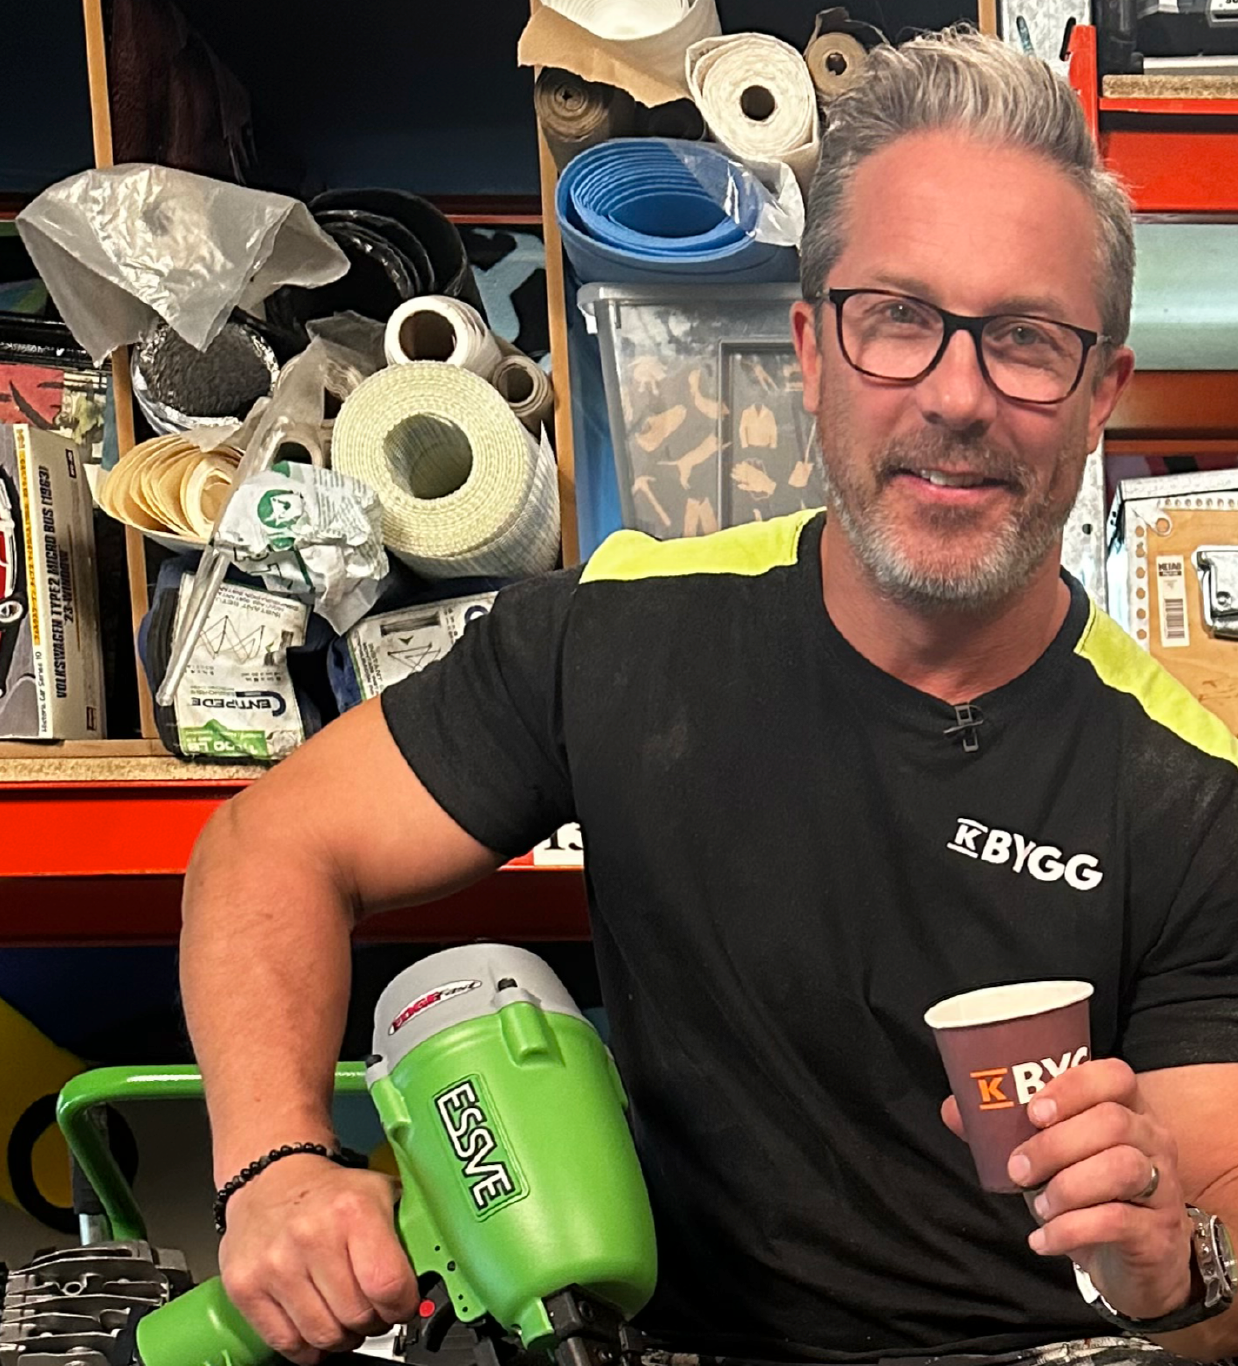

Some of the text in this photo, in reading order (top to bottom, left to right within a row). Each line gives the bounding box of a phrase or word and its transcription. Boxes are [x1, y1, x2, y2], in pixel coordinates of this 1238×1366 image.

[42, 507, 56, 532] BUS
[45, 533, 61, 574] MICRO
[35, 651, 42, 660] 10
[51, 619, 67, 698] VOLKSWAGEN
[37, 662, 45, 686] Series
[191, 691, 287, 717] CENTIPEDE
[435, 1080, 516, 1210] ESSVE
